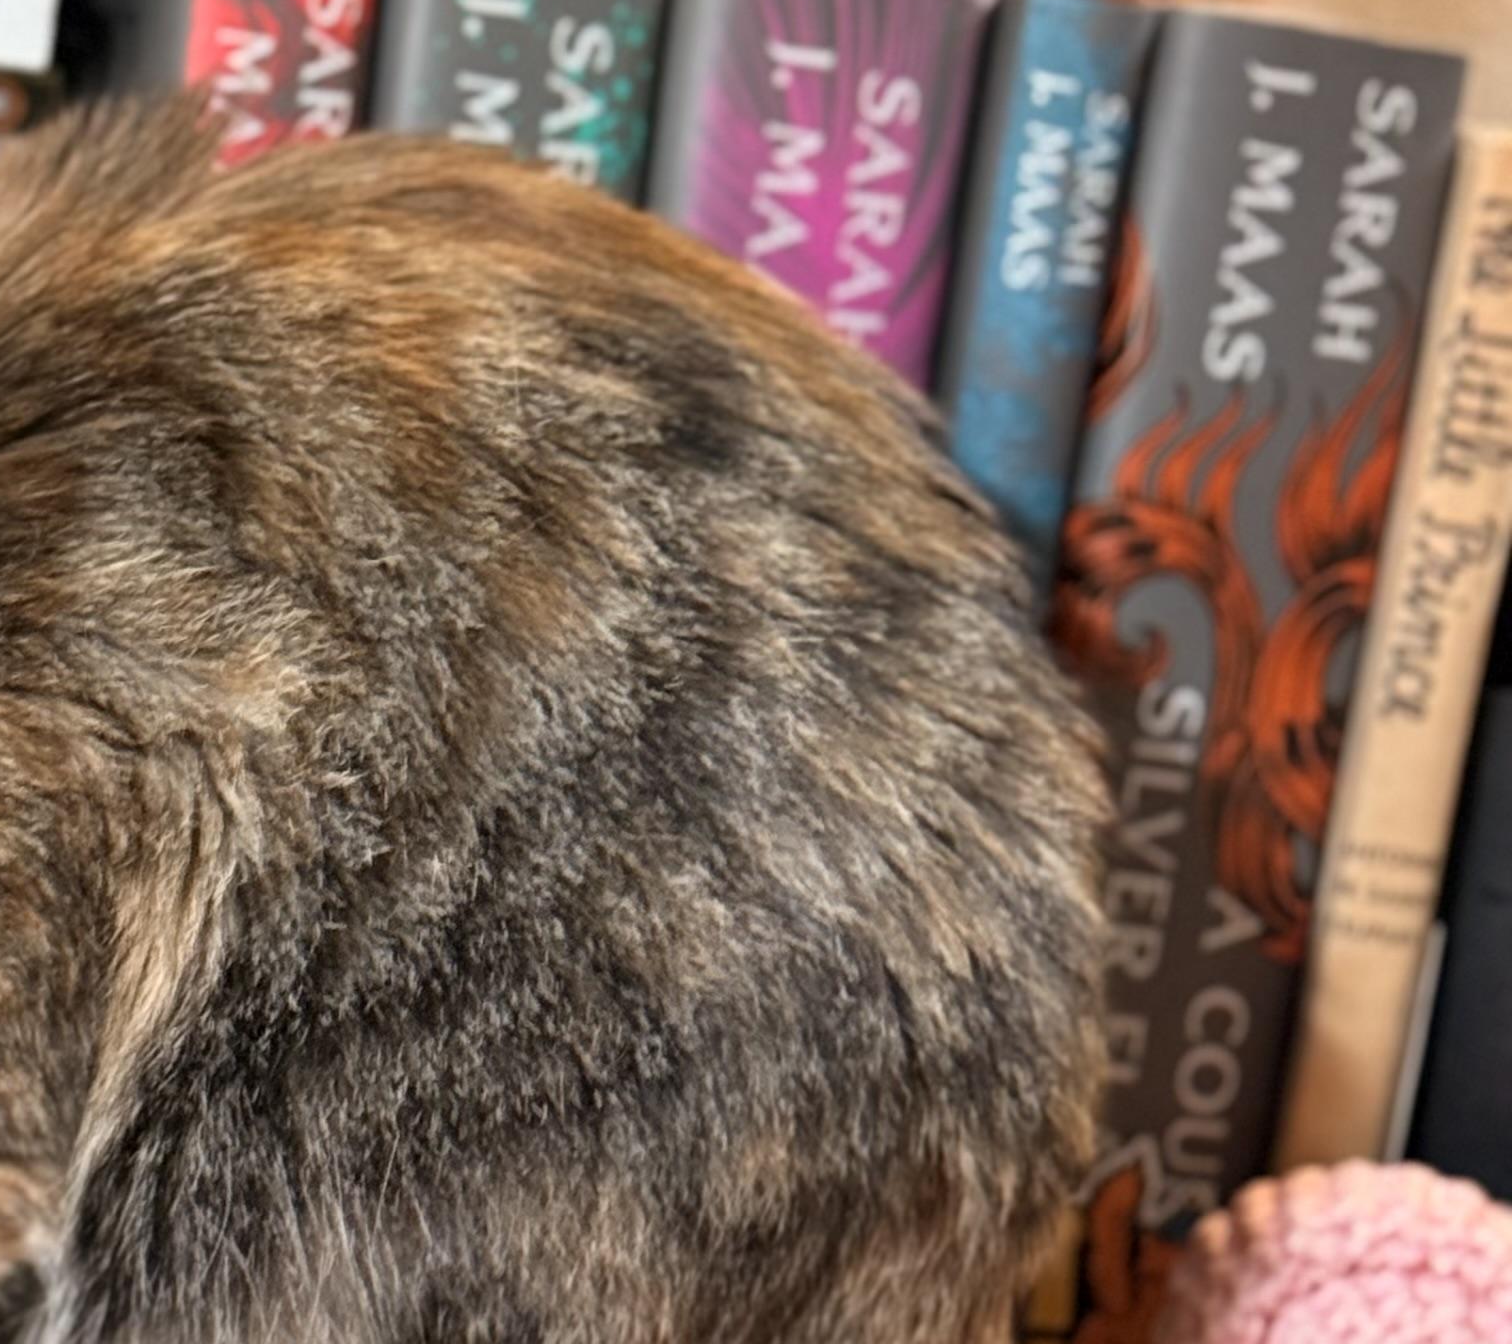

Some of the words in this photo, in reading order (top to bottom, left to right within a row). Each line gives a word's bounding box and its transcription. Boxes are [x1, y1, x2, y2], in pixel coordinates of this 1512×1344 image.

[1029, 68, 1083, 109] J.
[1244, 59, 1318, 113] J.
[999, 119, 1074, 293] MAAS
[1058, 89, 1131, 289] SARAH
[1201, 136, 1304, 384] MAAS
[1311, 76, 1418, 365] SARAH
[1101, 680, 1206, 984] SILVER
[1199, 886, 1266, 953] A
